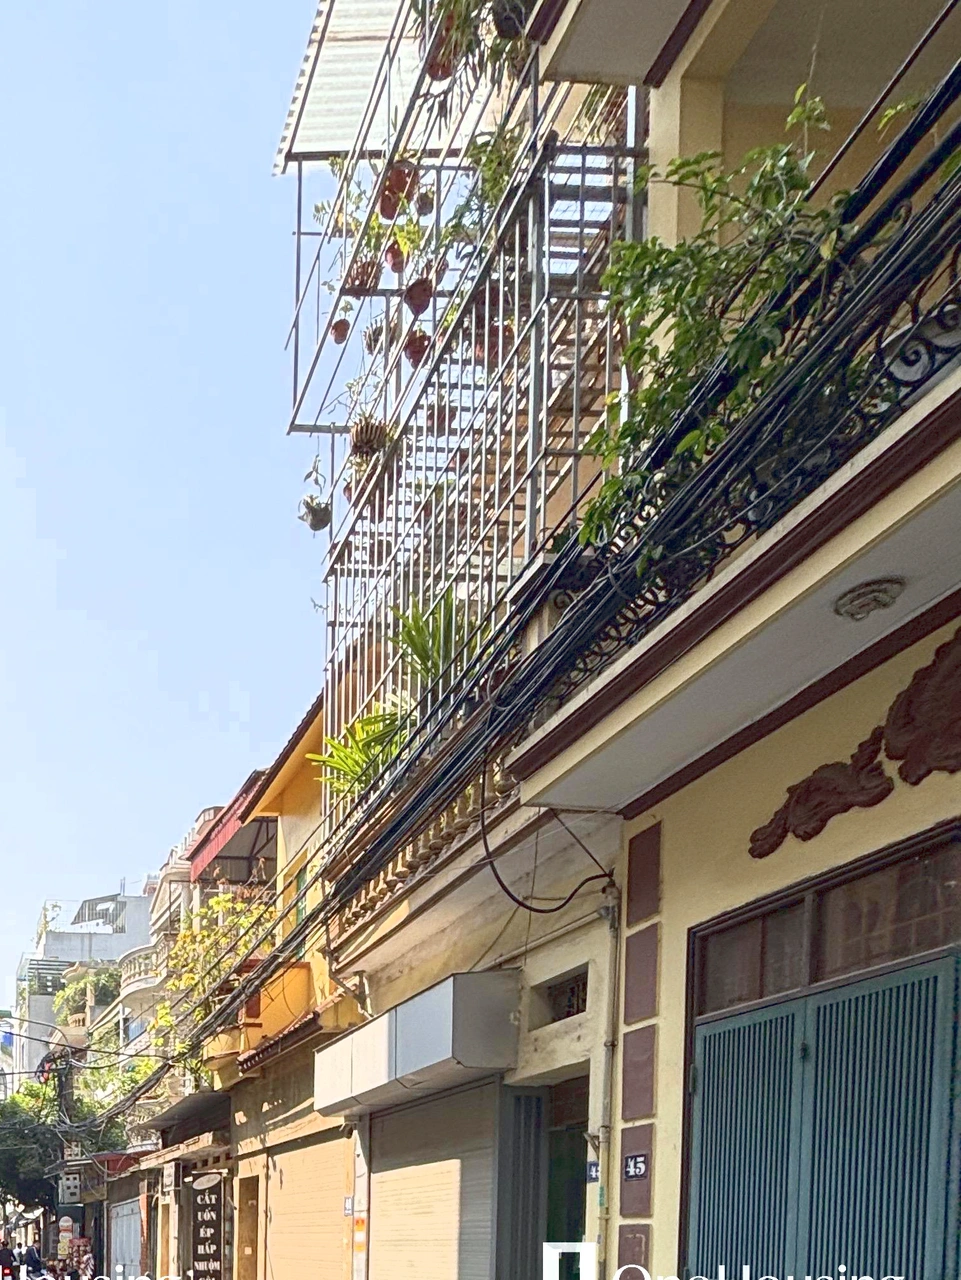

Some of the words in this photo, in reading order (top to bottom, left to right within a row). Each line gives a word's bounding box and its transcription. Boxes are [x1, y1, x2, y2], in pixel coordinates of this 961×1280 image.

[626, 1156, 646, 1177] 45
[196, 1190, 218, 1205] CẮT
[197, 1207, 217, 1221] UỐN
[199, 1225, 215, 1238] ÉP
[197, 1240, 217, 1255] HẤP
[194, 1259, 221, 1274] NHUỘM
